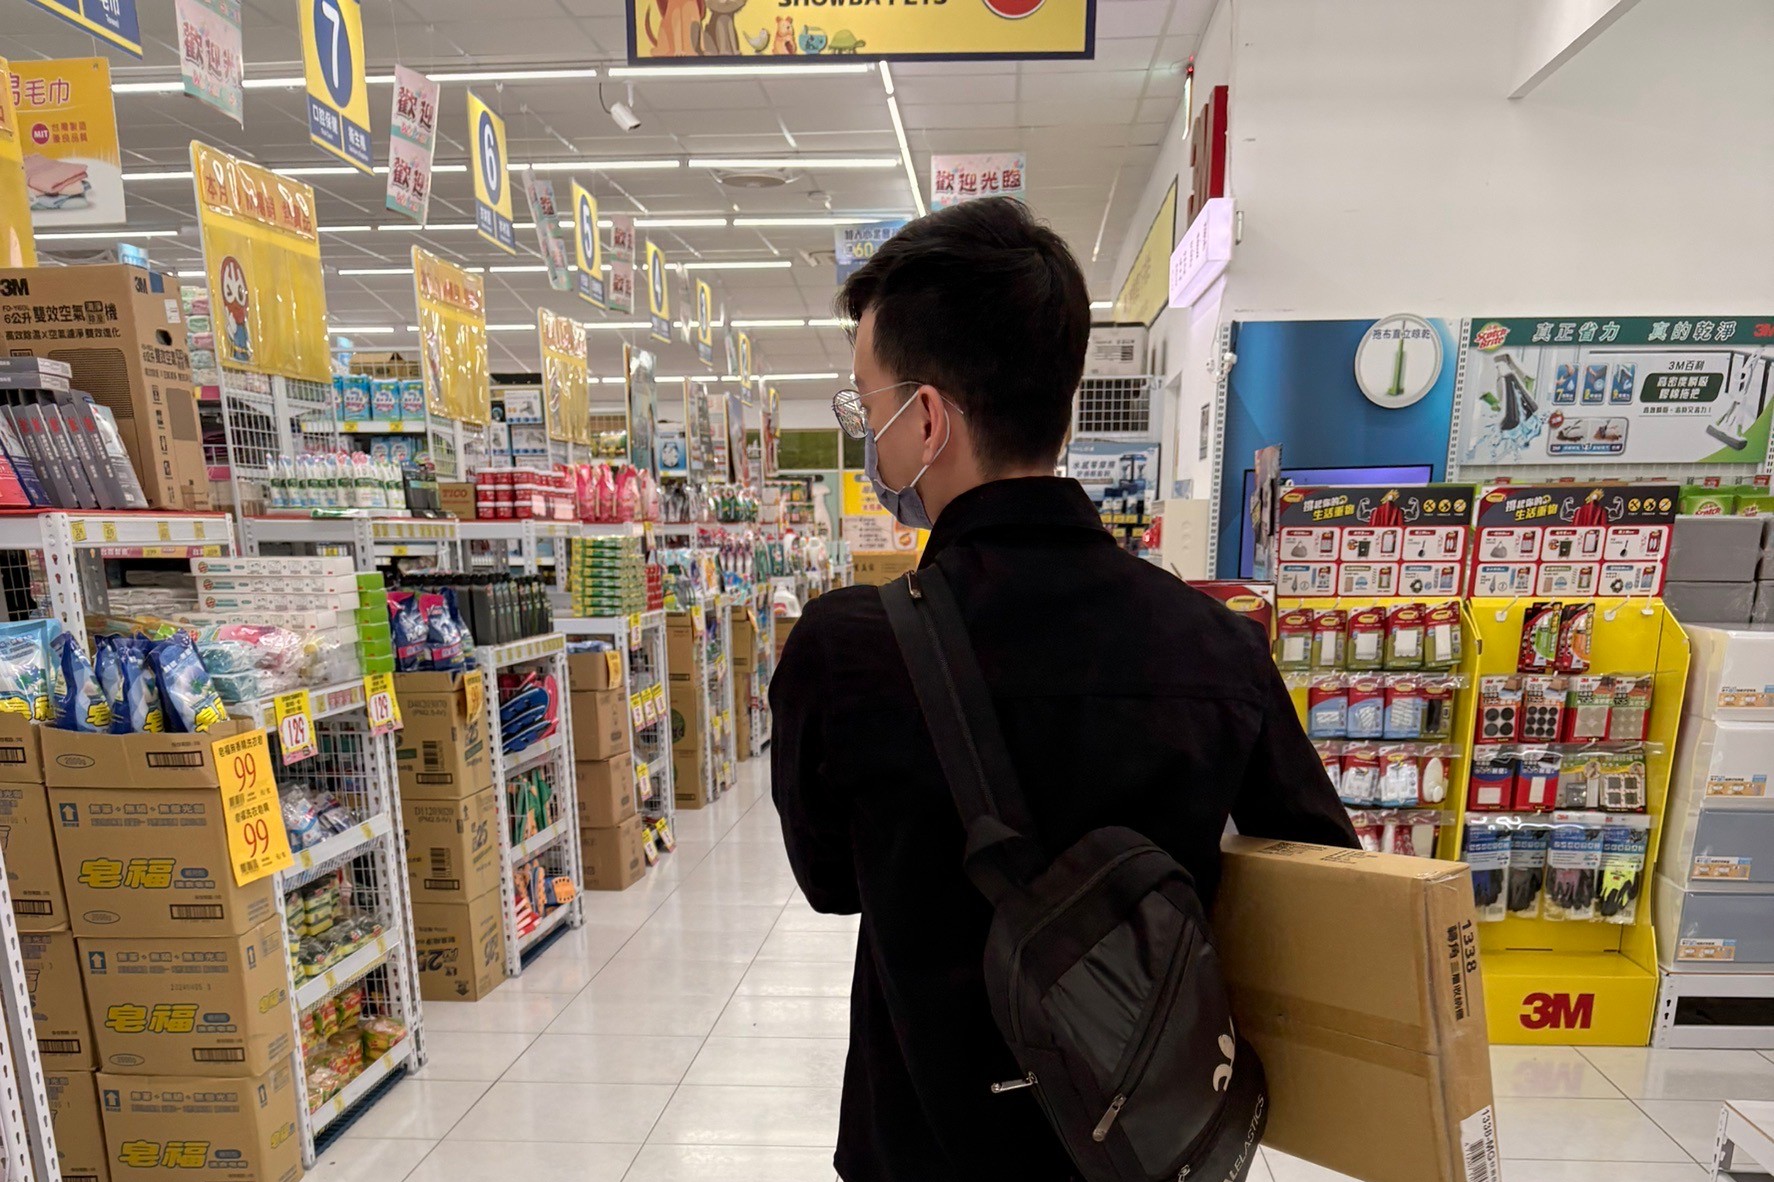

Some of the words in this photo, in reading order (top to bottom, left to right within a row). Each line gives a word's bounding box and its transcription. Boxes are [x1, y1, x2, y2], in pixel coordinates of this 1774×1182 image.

[321, 1, 340, 89] 7
[33, 129, 49, 139] MIT
[484, 123, 498, 191] 6
[935, 169, 1022, 193] 歡迎光臨
[582, 204, 593, 259] 5
[0, 278, 29, 297] 3M
[134, 276, 149, 295] 3M
[33, 304, 85, 323] 雙效空氣
[1532, 321, 1621, 342] 真正省力
[1648, 321, 1736, 342] 真的乾淨
[287, 716, 305, 747] 129
[233, 752, 257, 793] 99
[243, 818, 270, 859] 99
[77, 857, 177, 889] 皂福
[1462, 919, 1477, 973] 1338
[104, 1003, 200, 1034] 皂福
[1519, 992, 1596, 1030] 3M
[118, 1139, 211, 1169] 皂福
